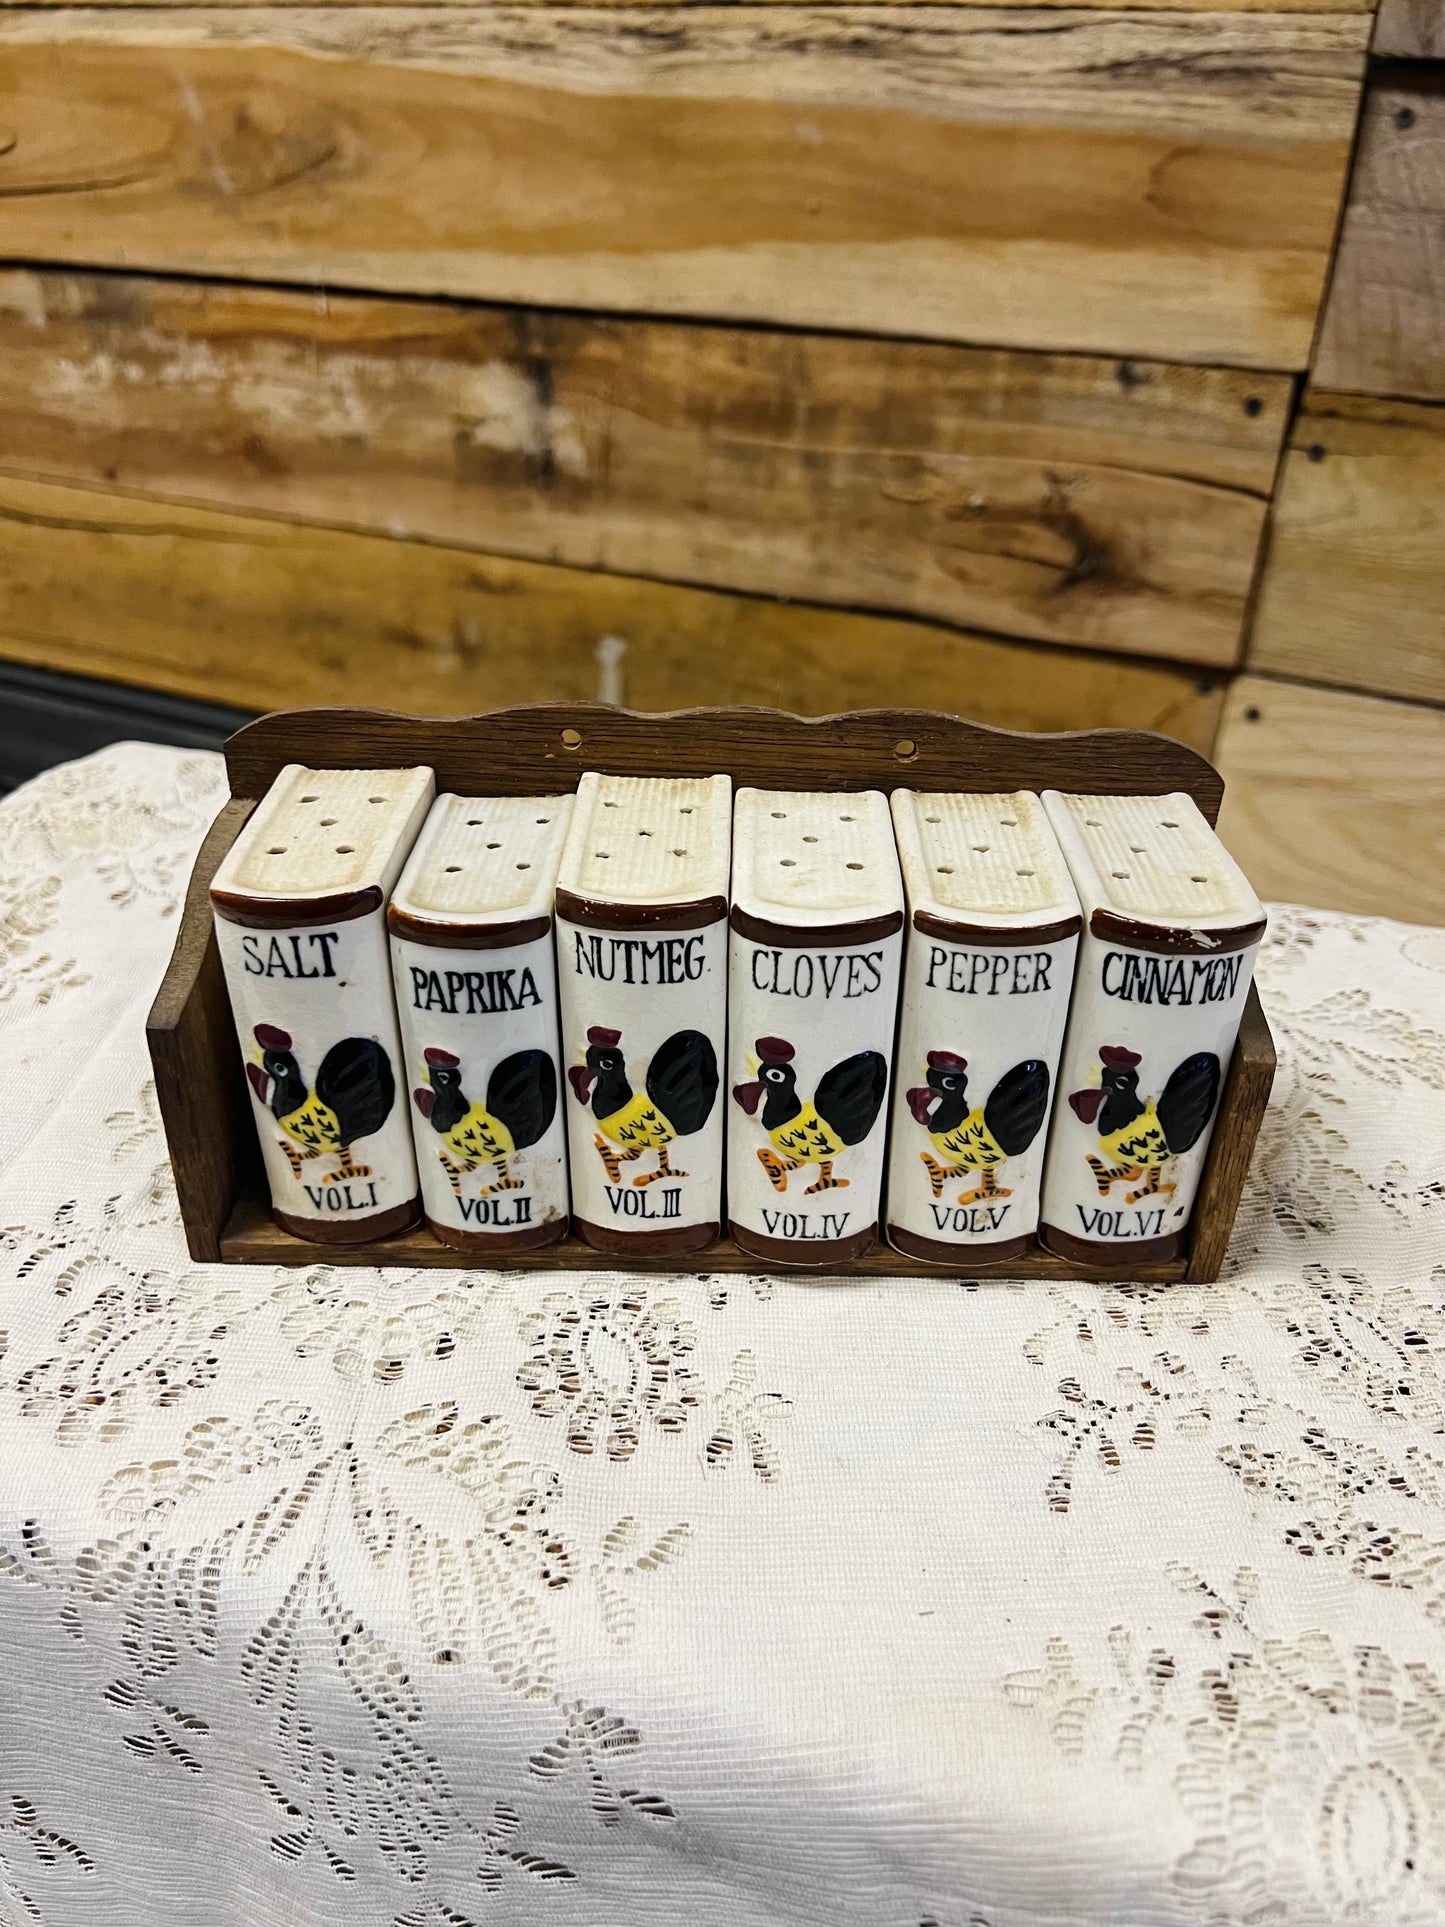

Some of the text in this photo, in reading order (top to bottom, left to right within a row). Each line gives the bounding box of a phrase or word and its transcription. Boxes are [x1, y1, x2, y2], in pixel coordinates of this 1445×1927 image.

[242, 932, 339, 979] SALT
[574, 931, 706, 985] NUTMEG
[752, 950, 883, 999] CLOVES
[925, 946, 1052, 996] PEPPER
[1101, 951, 1244, 1006] CINNAMON
[409, 967, 543, 1014] PAPRIKA
